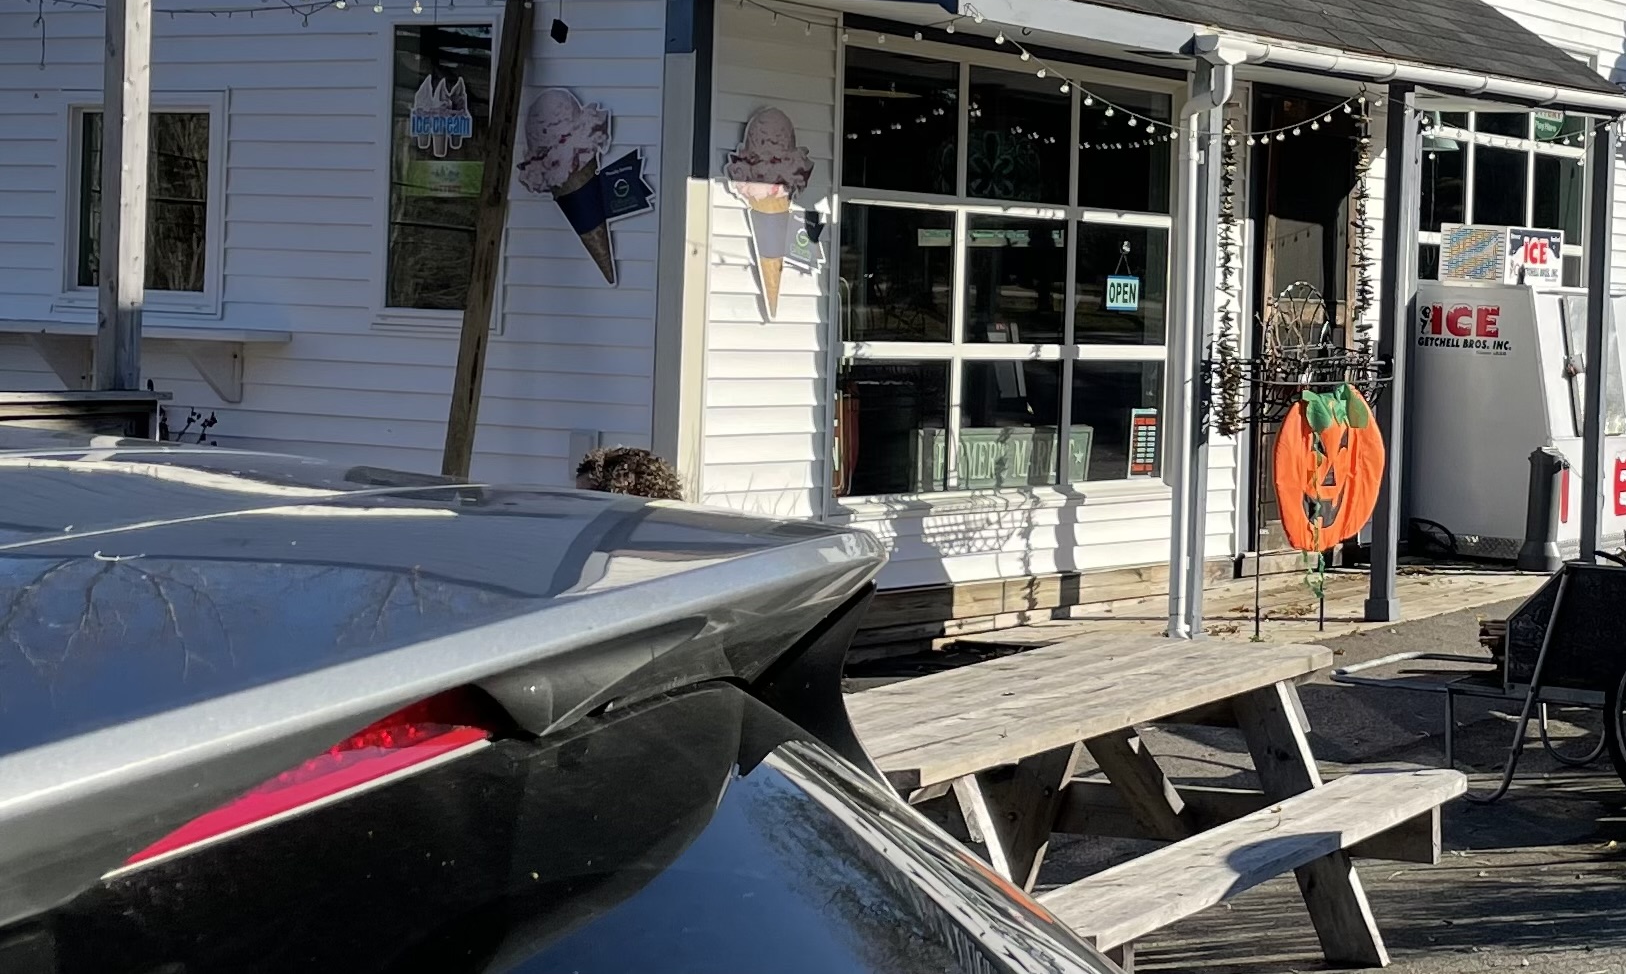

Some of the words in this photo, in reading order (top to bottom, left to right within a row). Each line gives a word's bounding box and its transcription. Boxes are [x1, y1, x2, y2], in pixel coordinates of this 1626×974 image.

[1523, 237, 1549, 265] ICE
[1109, 282, 1136, 304] OPEN
[1431, 302, 1500, 337] ICE
[1417, 336, 1460, 349] GETCHELL
[1462, 338, 1490, 350] BROS.
[1493, 340, 1512, 351] INC.
